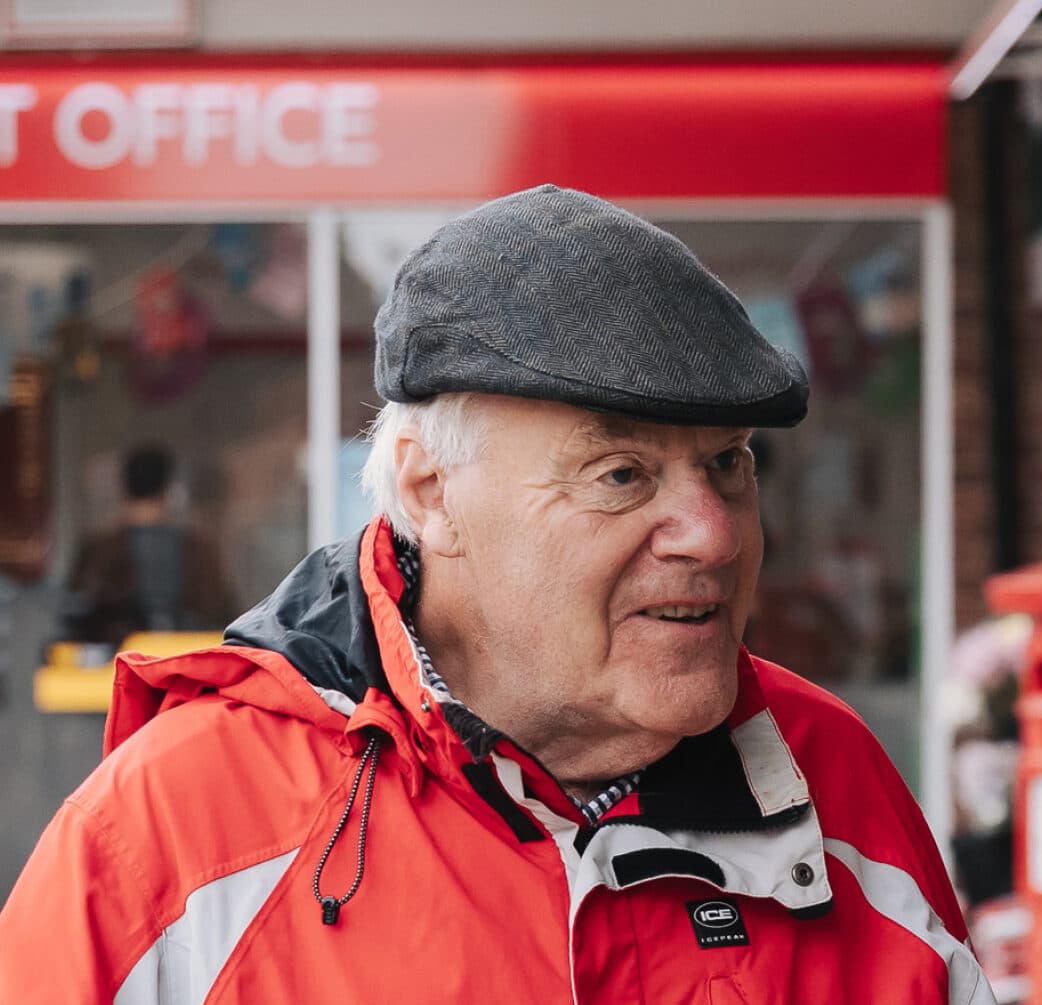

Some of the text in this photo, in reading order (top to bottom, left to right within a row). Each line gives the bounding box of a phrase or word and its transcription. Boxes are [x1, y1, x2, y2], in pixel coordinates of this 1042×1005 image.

[54, 81, 380, 170] OFFICE
[700, 909, 733, 921] ICE
[701, 935, 744, 943] ICEPEAK
